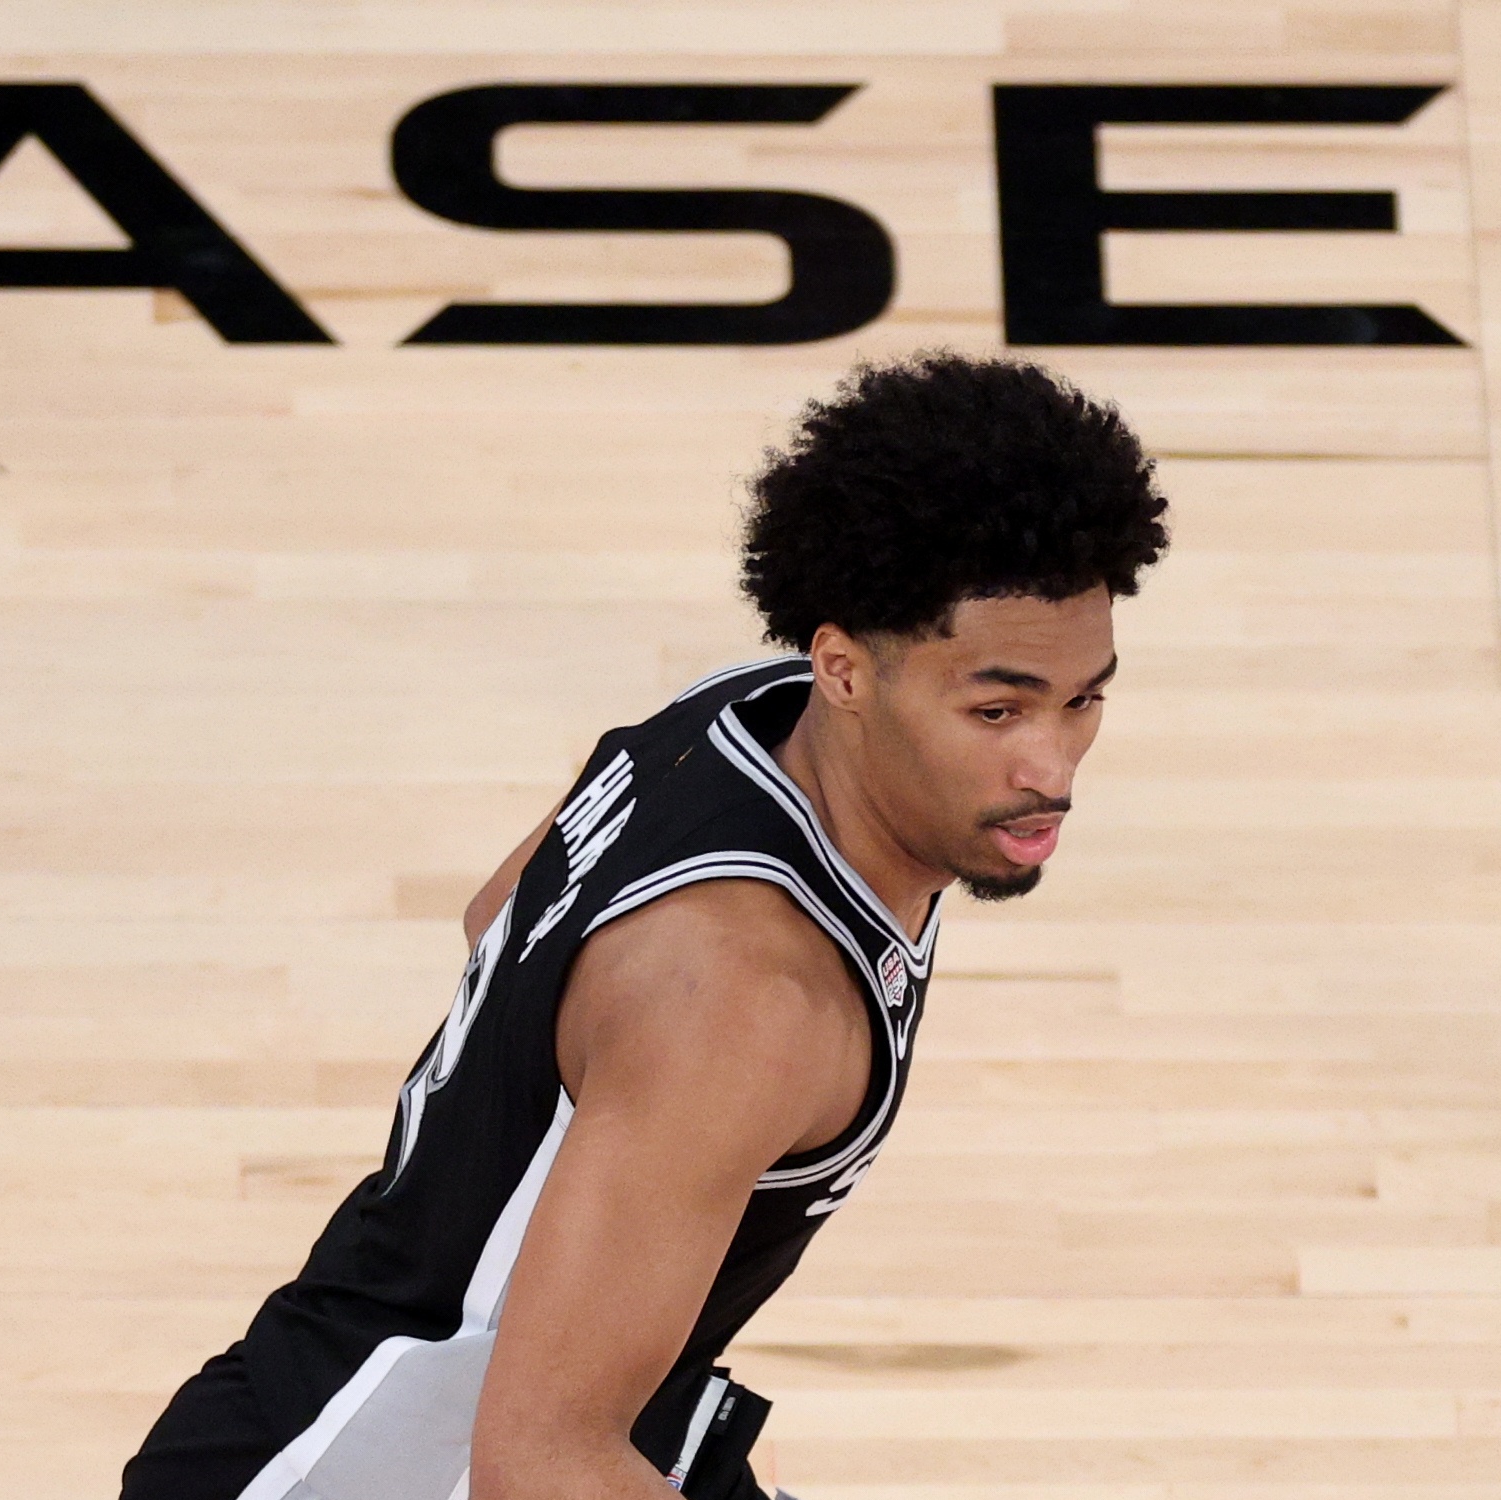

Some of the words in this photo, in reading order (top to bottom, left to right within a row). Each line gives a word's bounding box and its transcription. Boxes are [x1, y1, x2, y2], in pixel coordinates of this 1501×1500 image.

[518, 748, 636, 964] HARPR
[882, 951, 900, 978] USA
[887, 971, 905, 1001] 250
